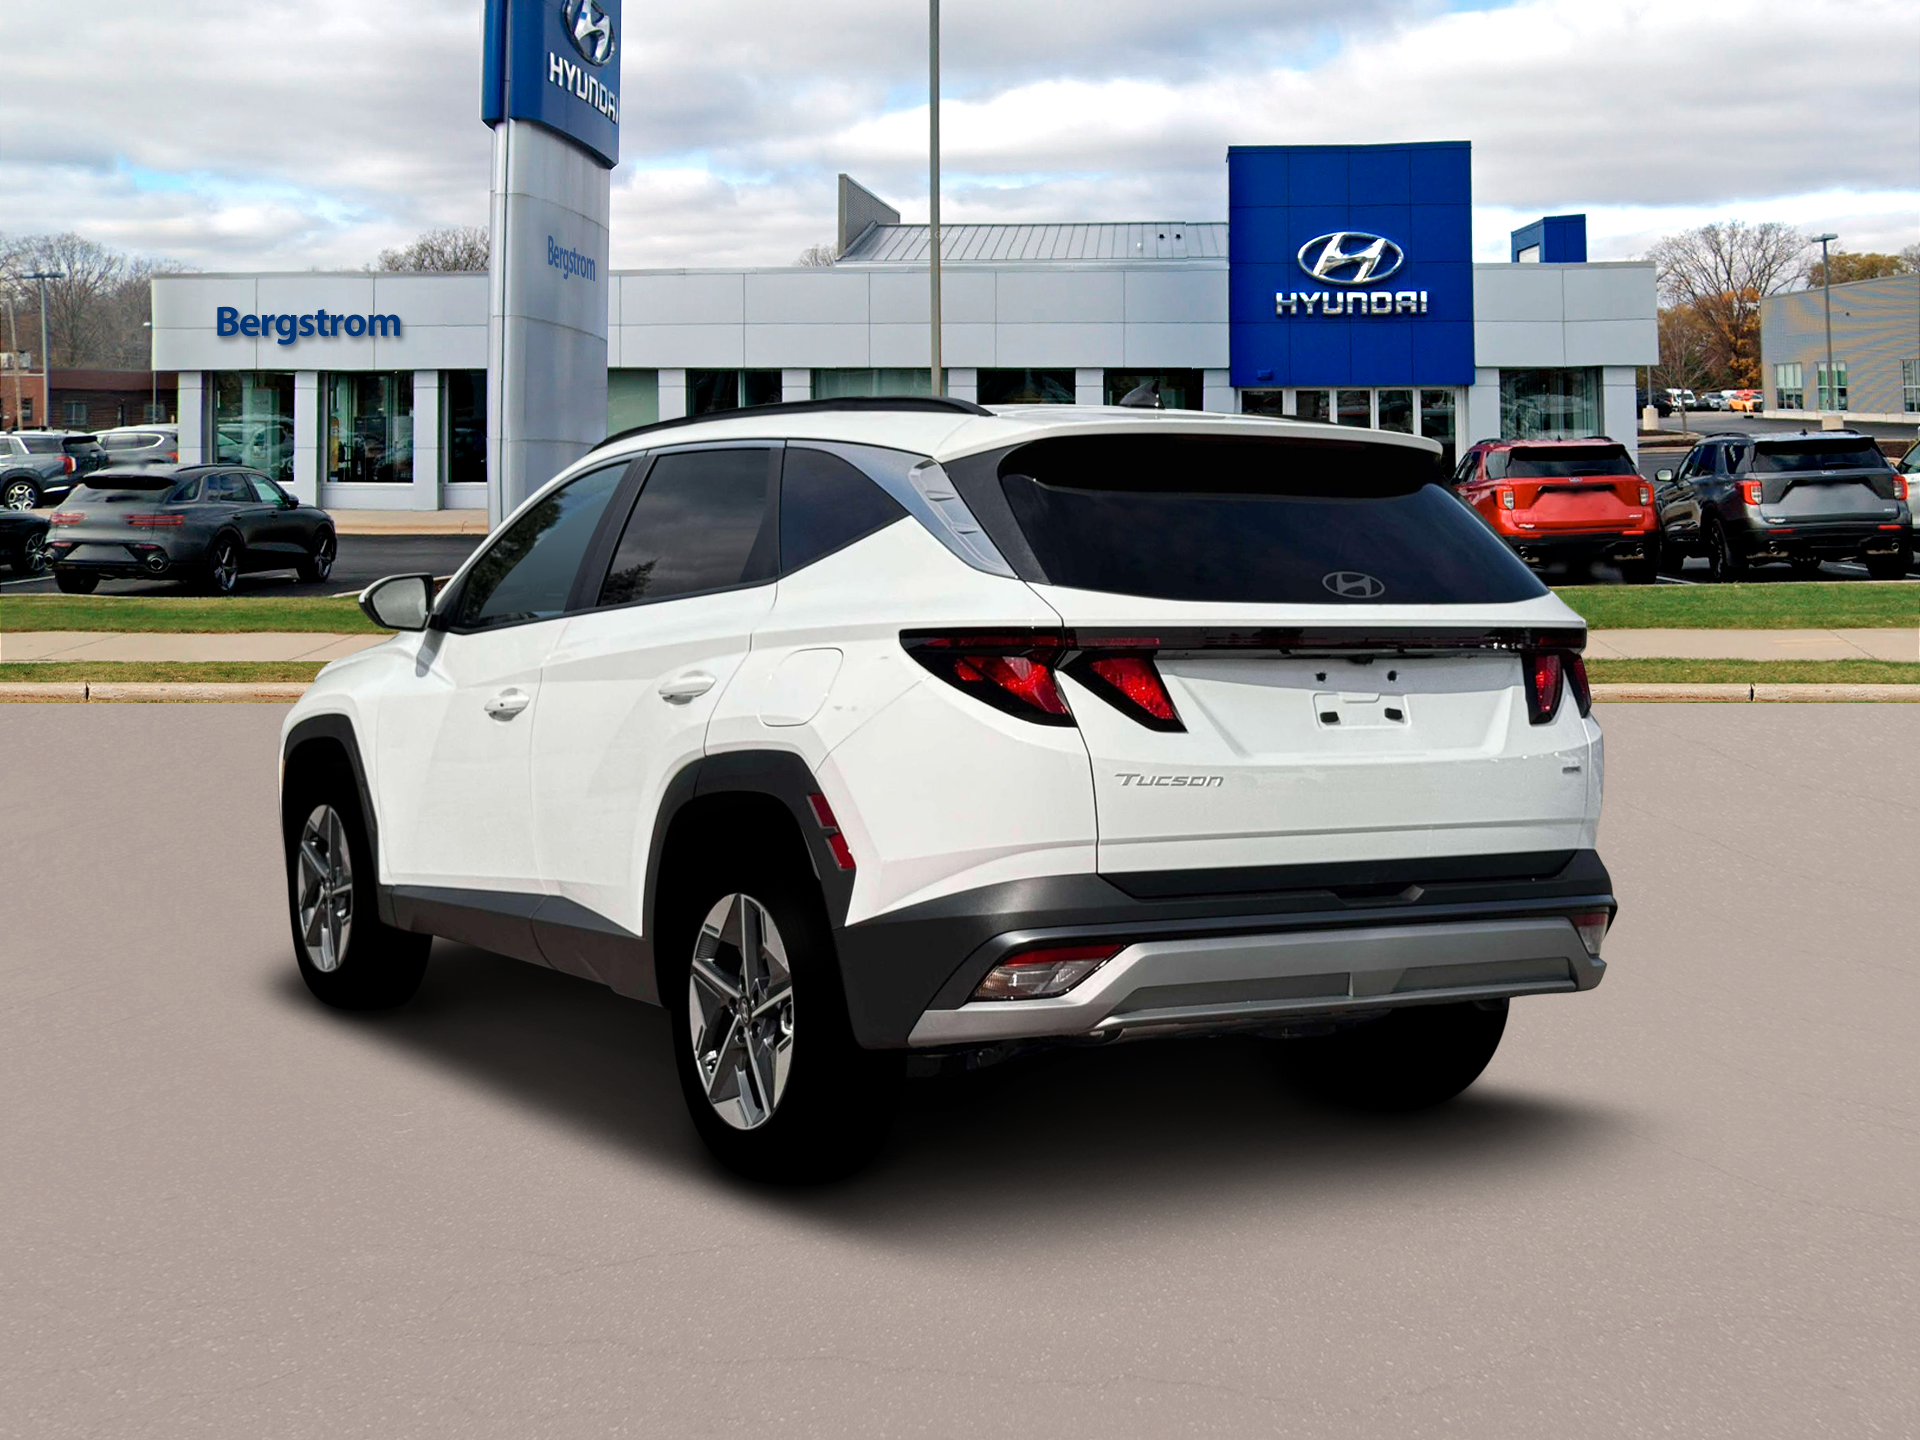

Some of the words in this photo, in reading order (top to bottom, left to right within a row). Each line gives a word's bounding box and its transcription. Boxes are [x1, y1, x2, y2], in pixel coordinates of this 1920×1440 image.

[549, 52, 619, 124] HYUNDAI
[547, 235, 596, 281] Bergstrom
[1275, 290, 1428, 315] HYUNDAI
[217, 306, 402, 346] Bergstrom
